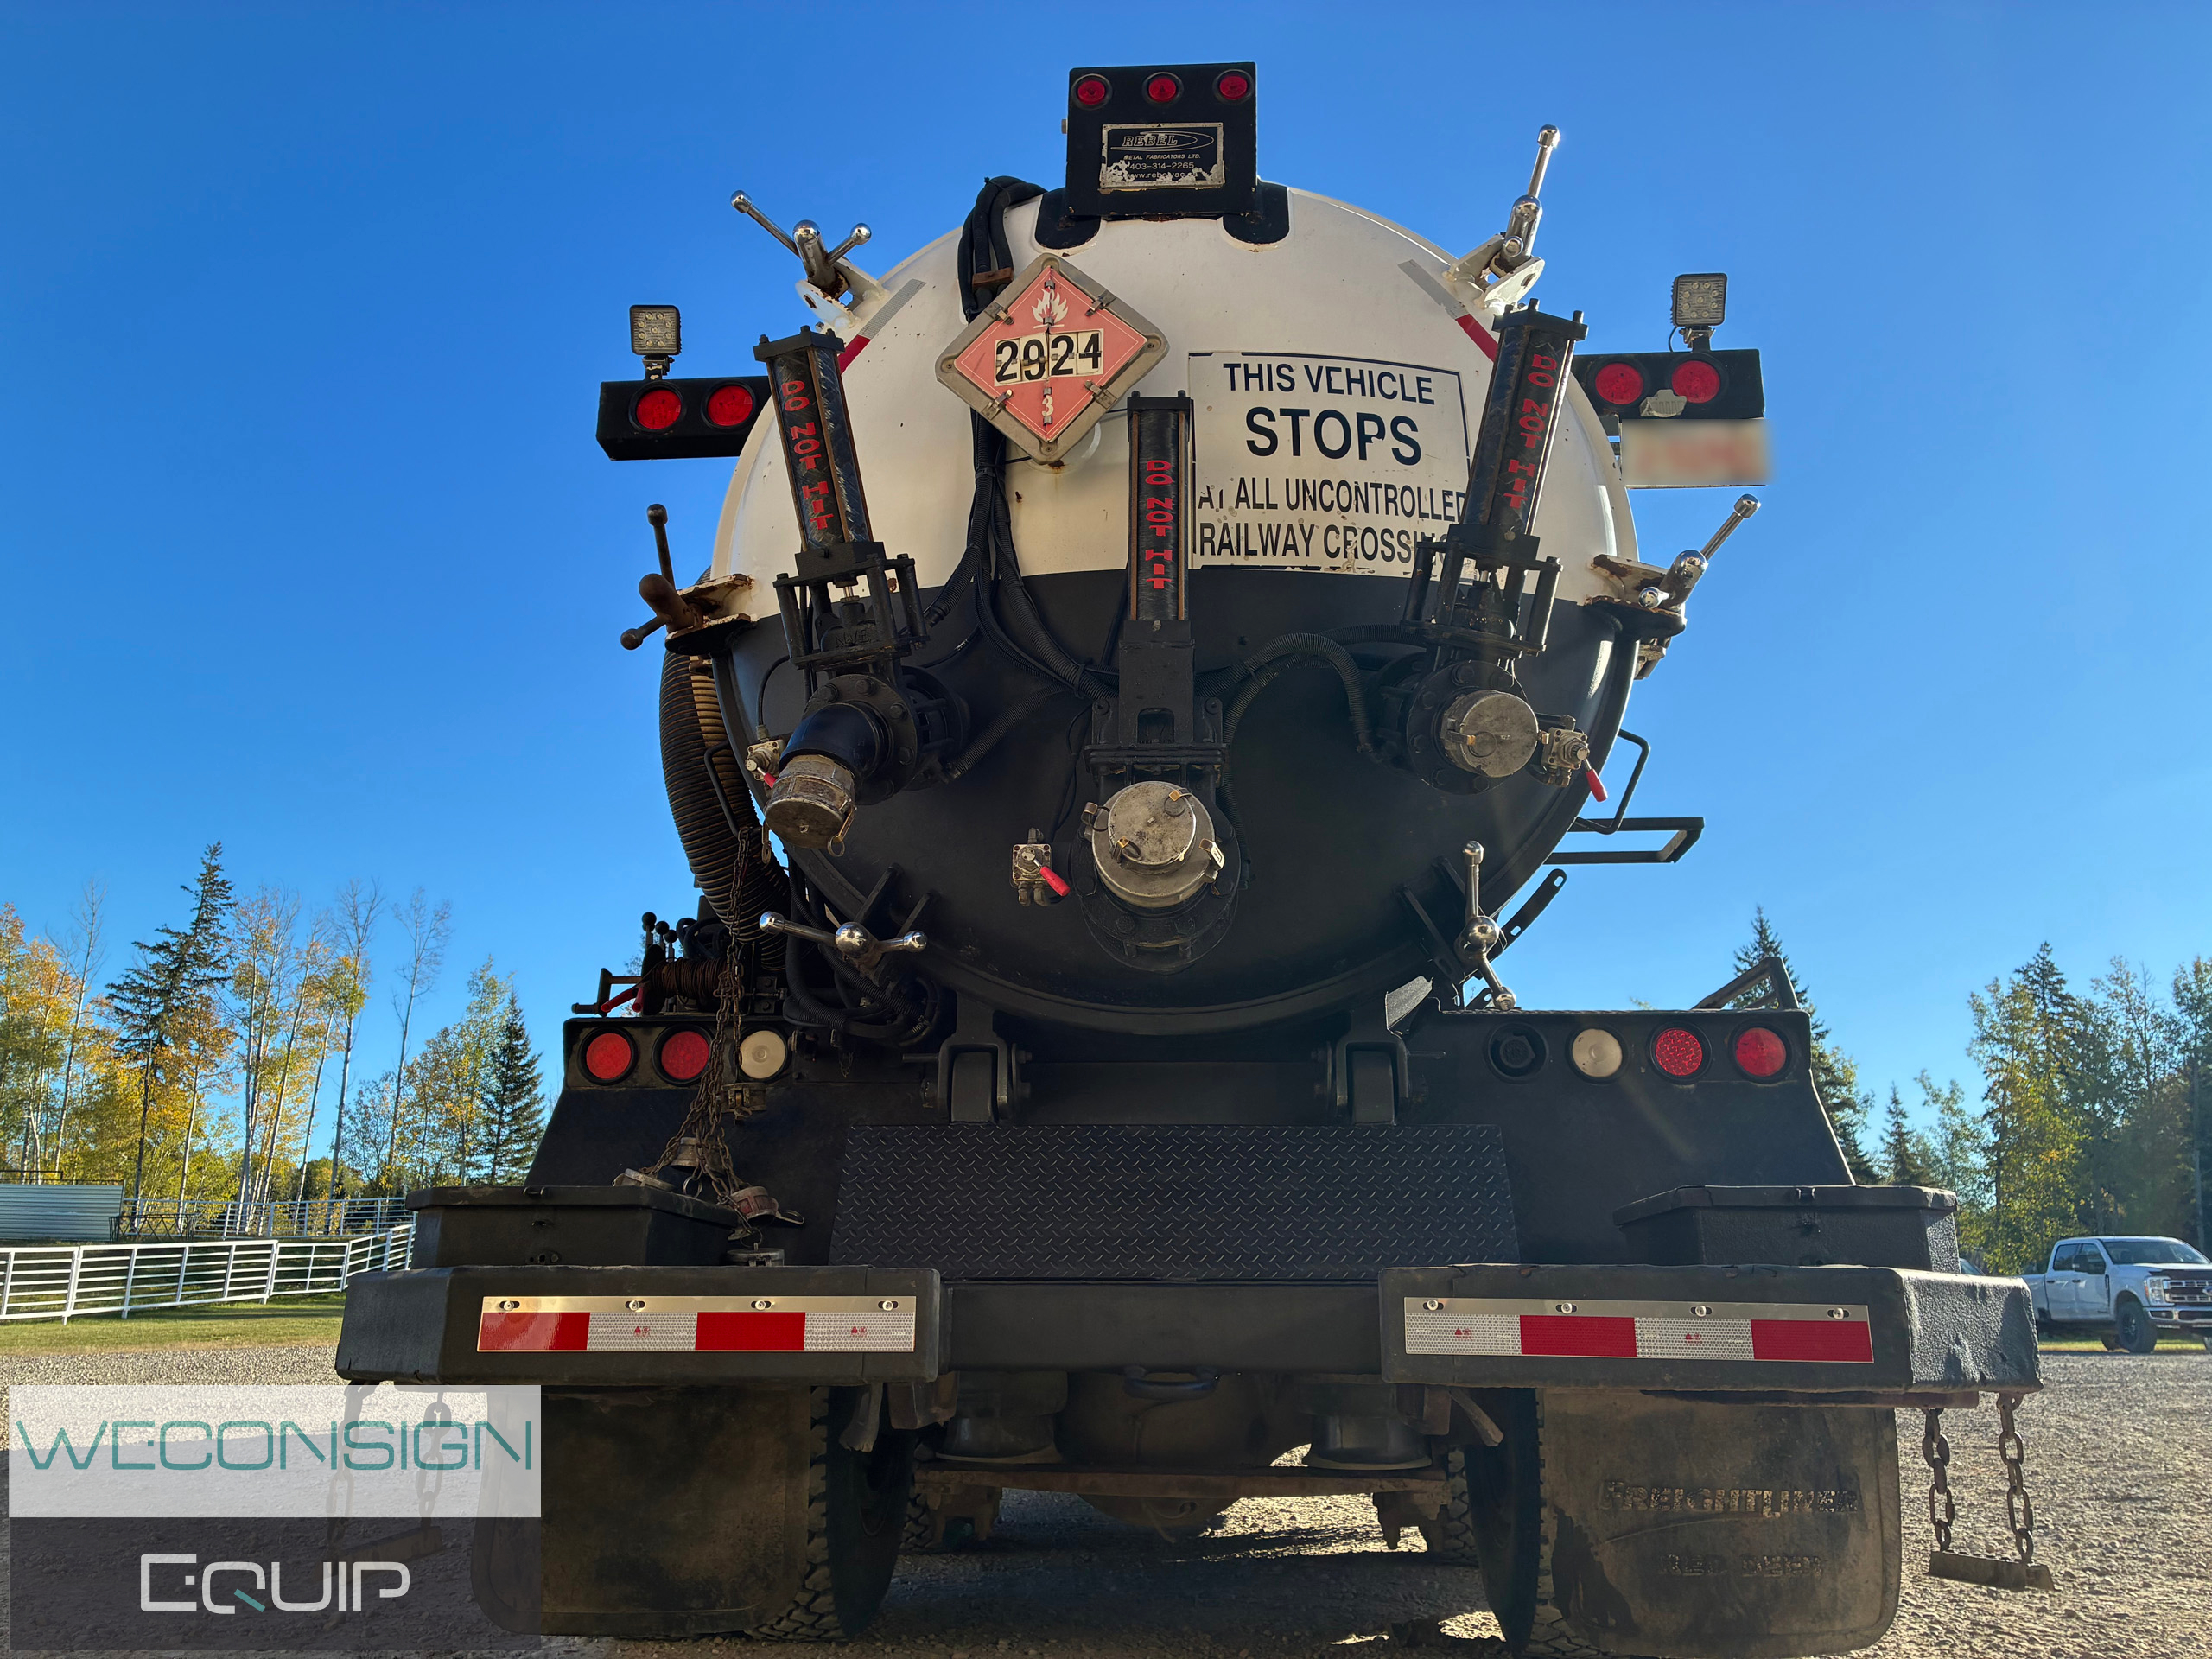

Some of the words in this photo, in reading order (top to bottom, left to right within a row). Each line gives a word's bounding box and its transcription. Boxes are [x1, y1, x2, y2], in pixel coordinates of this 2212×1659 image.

[1122, 136, 1178, 146] REBEL
[1129, 162, 1195, 170] 403-314-2265
[995, 333, 1102, 382] 2924
[1529, 353, 1557, 388] DO
[781, 380, 810, 412] DO
[1223, 362, 1296, 393] THIS
[1304, 365, 1435, 405] VEHICLE
[1041, 395, 1054, 416] 3
[1518, 398, 1548, 449] NOT
[790, 422, 822, 470] NOT
[1246, 406, 1421, 466] STOPS
[1146, 460, 1173, 485] DO
[1503, 459, 1535, 509] HIT
[801, 480, 835, 531] HIT
[1235, 477, 1279, 510] ALL
[1145, 497, 1173, 537] NOT
[1199, 522, 1316, 557] RAILWAY
[1323, 524, 1448, 567] CROSSI
[1145, 549, 1173, 589] HIT
